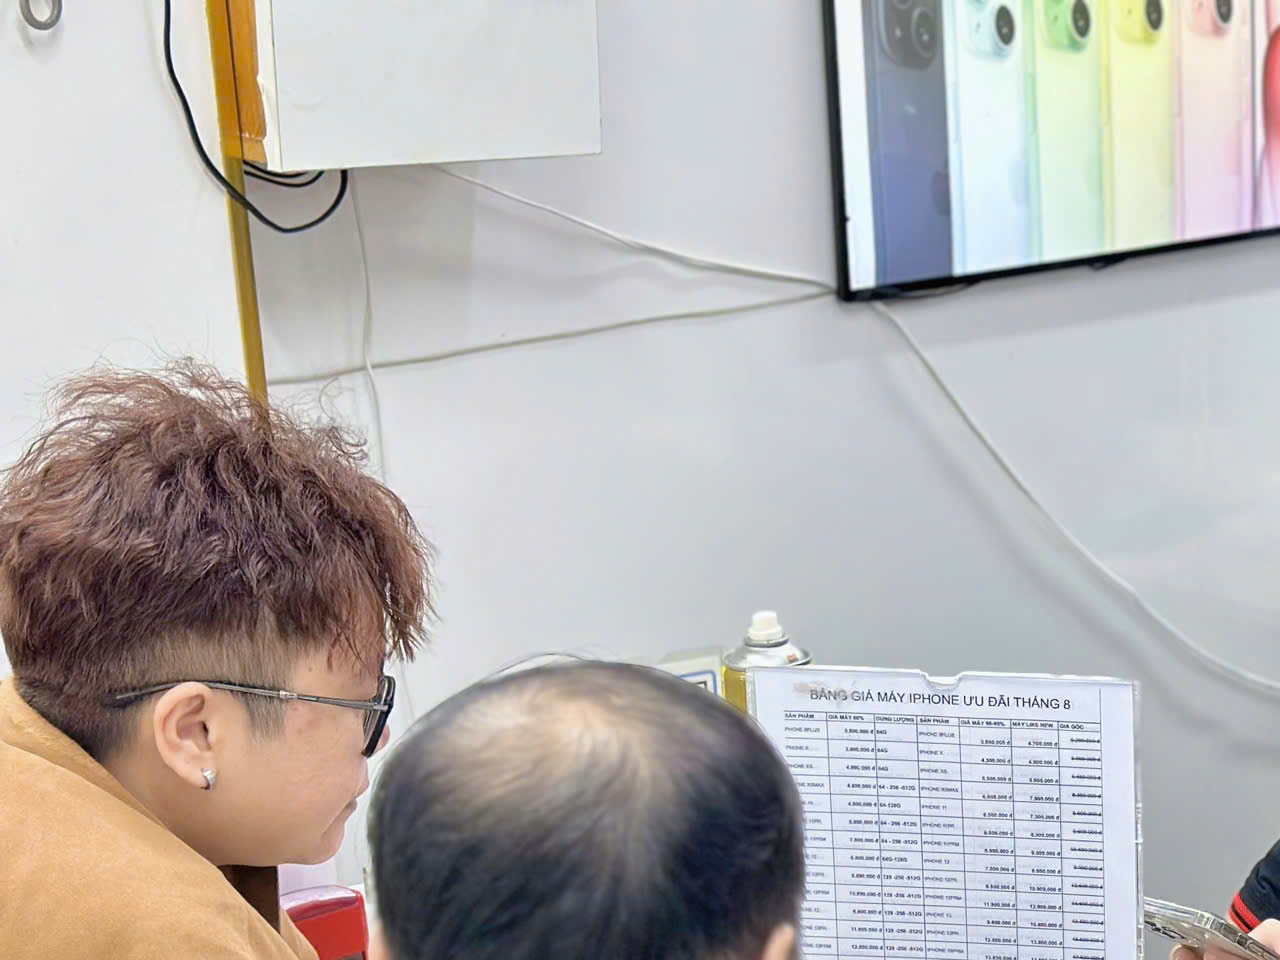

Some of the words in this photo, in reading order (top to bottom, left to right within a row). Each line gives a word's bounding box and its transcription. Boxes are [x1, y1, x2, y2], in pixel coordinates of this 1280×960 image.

[810, 688, 848, 701] BẢNG
[852, 689, 874, 701] GIÁ
[878, 691, 905, 702] MÁY
[910, 692, 960, 706] IPHONE
[963, 695, 984, 707] ƯU
[988, 695, 1010, 707] ĐÃI
[1013, 695, 1060, 709] THÁNG
[1063, 700, 1071, 709] 8
